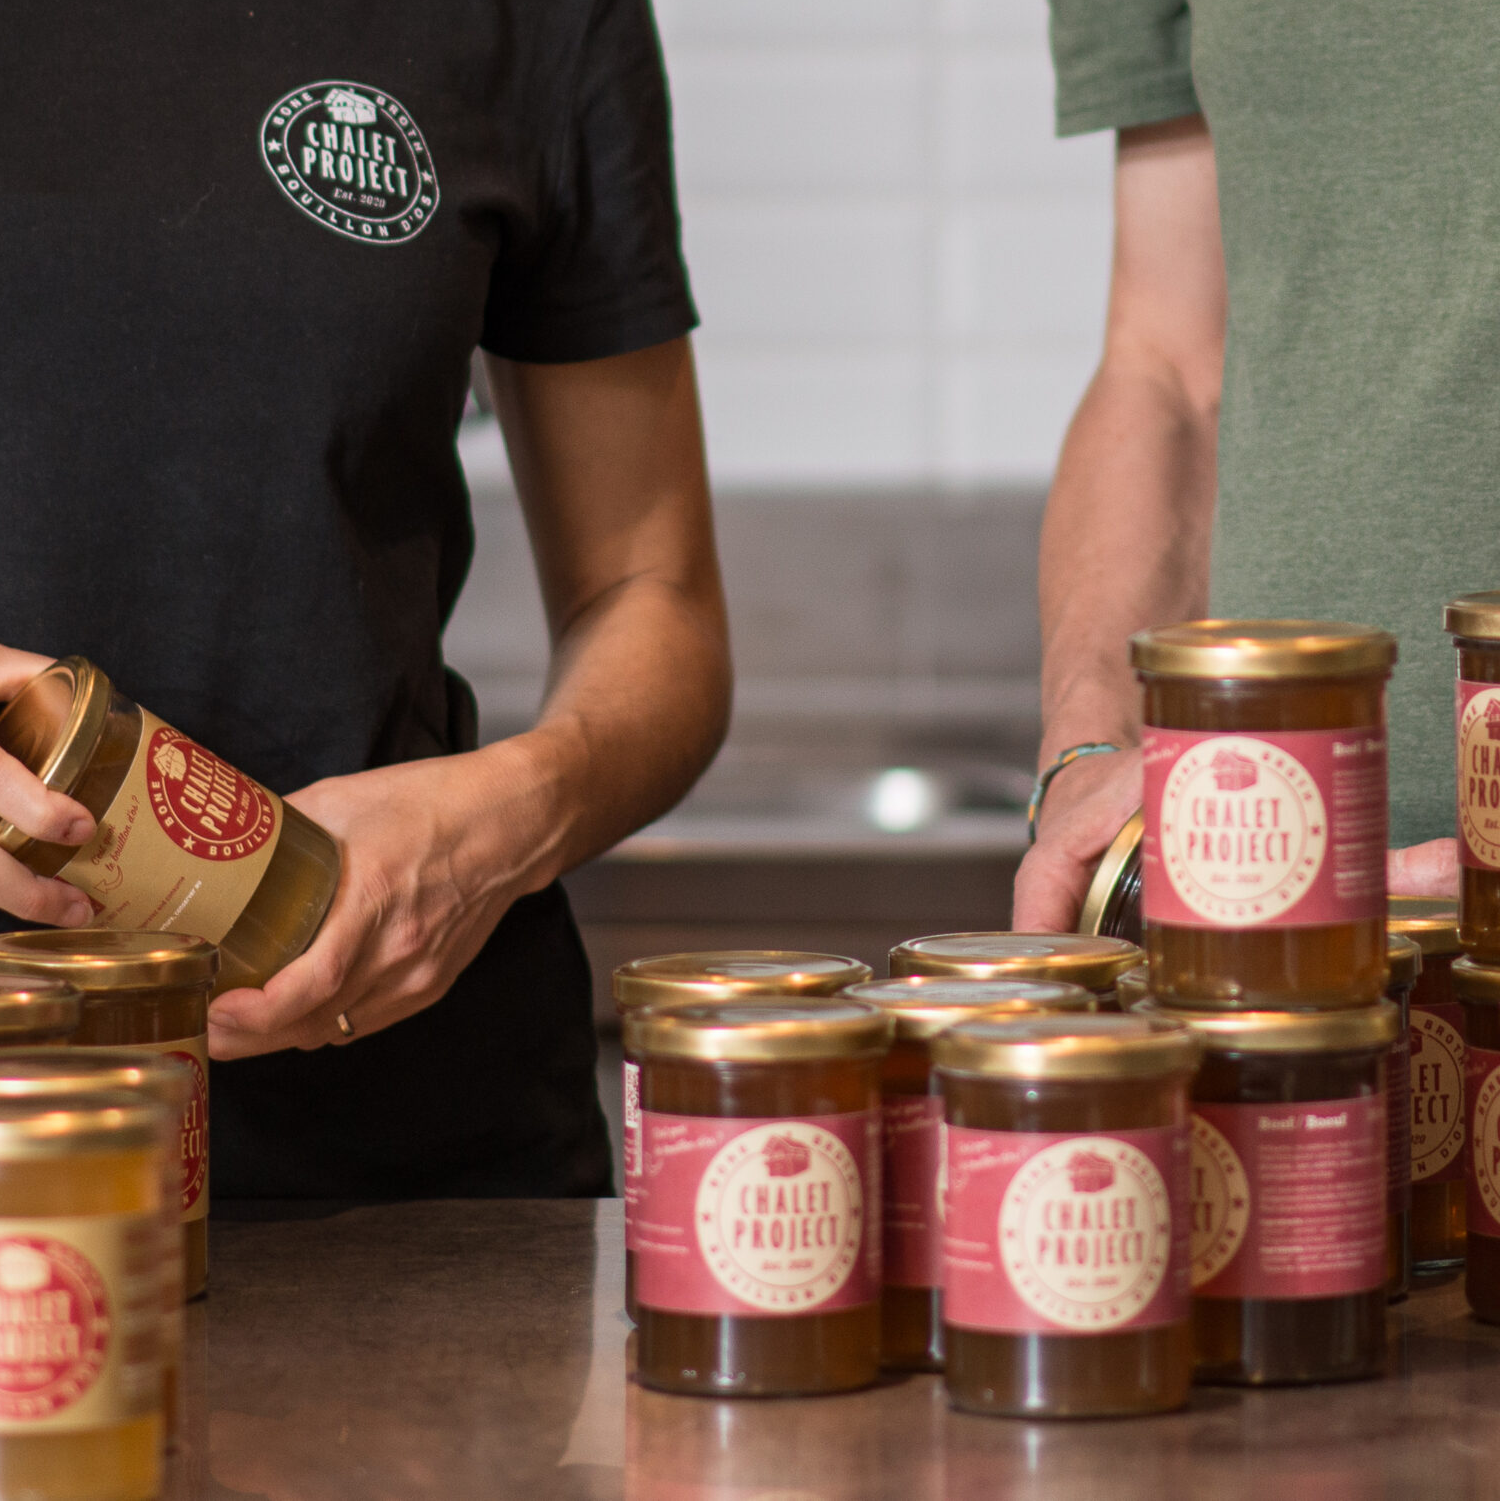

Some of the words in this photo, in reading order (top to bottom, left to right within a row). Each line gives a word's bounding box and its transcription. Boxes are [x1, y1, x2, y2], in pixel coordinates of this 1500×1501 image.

[273, 92, 313, 126] BONE
[376, 95, 424, 153] BROTH
[307, 122, 396, 165] CHALET
[303, 146, 408, 197] PROJECT
[278, 163, 389, 237] BOUILLON
[400, 195, 432, 232] D'OS
[333, 187, 356, 202] Est.
[180, 749, 214, 814] CHALET
[200, 761, 238, 836] PROJECT
[152, 781, 175, 828] BONE
[1192, 797, 1280, 828] CHALET
[113, 824, 133, 862] bouillon
[210, 804, 271, 856] BOUILLON
[1187, 831, 1291, 865] PROJECT
[740, 1181, 831, 1215] CHALET
[1044, 1197, 1136, 1230] CHALET
[734, 1215, 840, 1251] PROJECT
[1037, 1231, 1143, 1269] PROJECT
